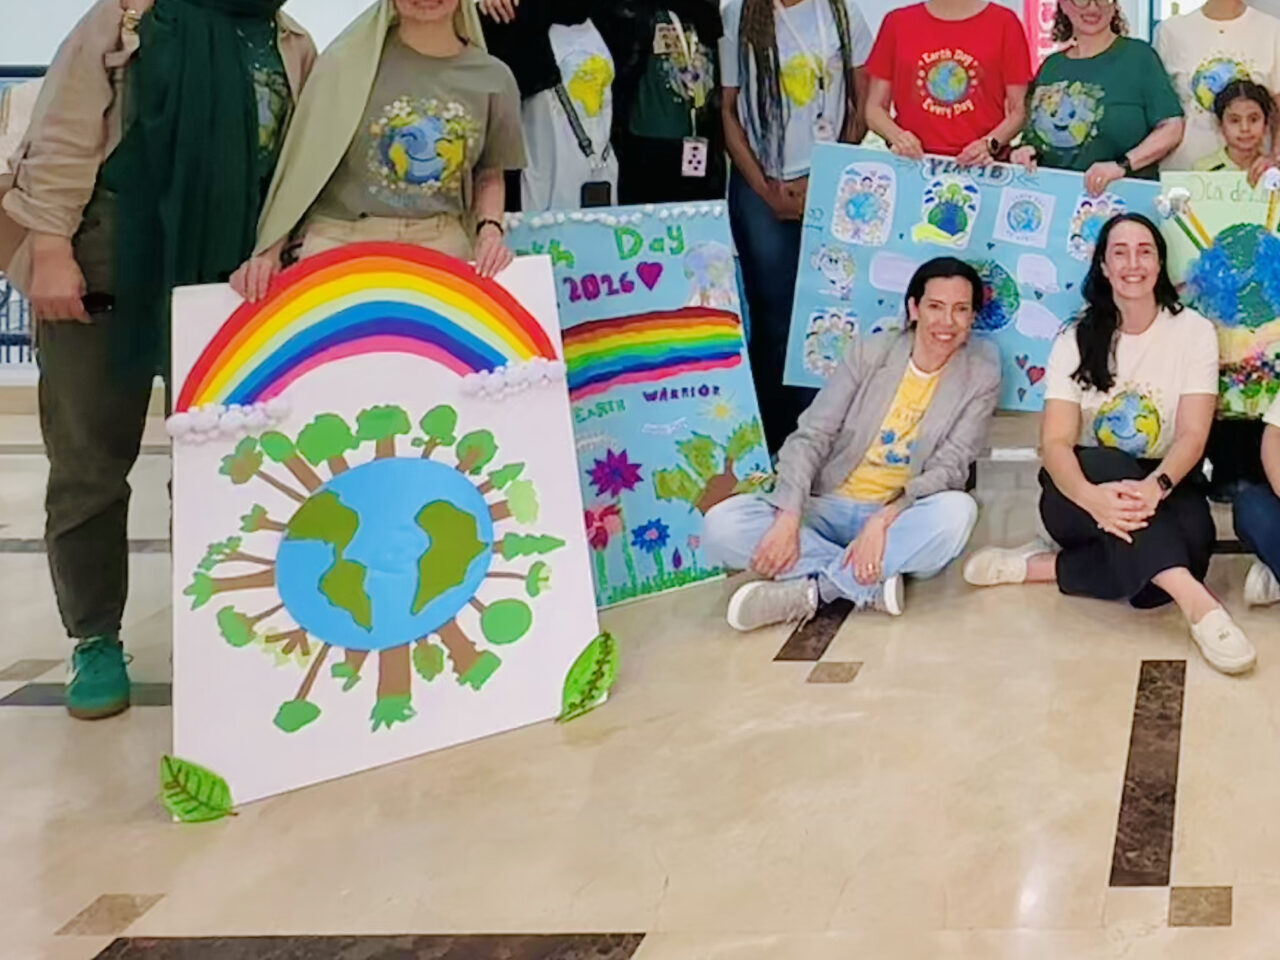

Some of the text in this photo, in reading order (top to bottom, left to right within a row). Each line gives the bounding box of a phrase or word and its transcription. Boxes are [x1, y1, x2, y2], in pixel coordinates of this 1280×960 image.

[922, 48, 974, 67] Earth Day
[922, 98, 974, 119] Every Day
[614, 224, 685, 261] Day
[563, 272, 635, 303] 2026
